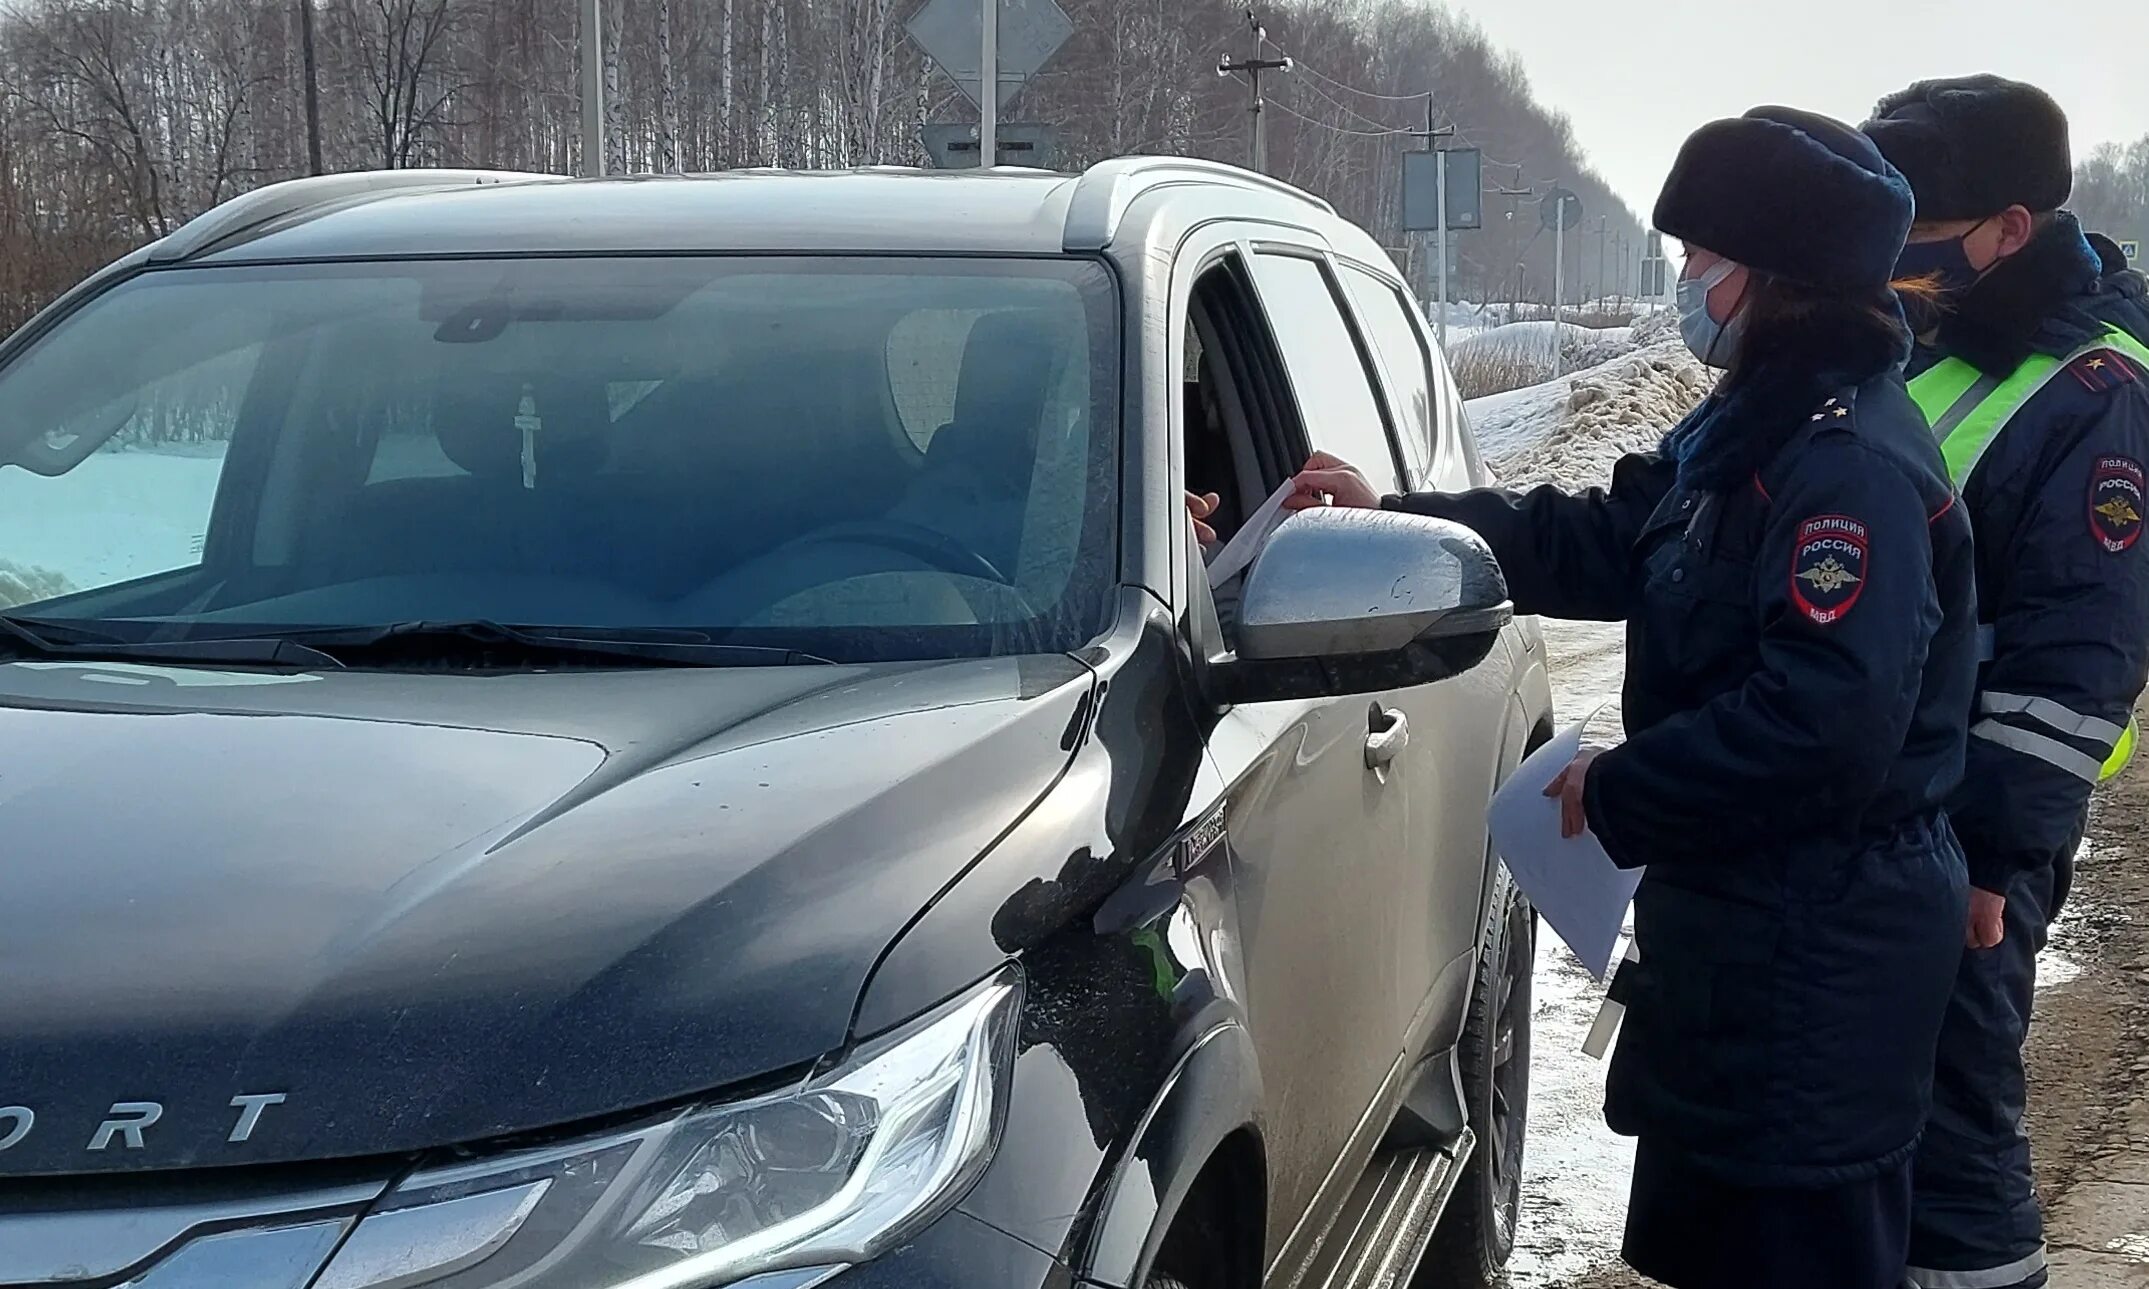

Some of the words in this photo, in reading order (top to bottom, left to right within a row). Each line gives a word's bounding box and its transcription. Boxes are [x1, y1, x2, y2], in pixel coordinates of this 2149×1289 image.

[1804, 519, 1865, 537] ПОЛИЦИЯ
[1803, 539, 1861, 559] РОССИЯ
[2104, 536, 2124, 552] МВД
[1810, 608, 1836, 623] МВД
